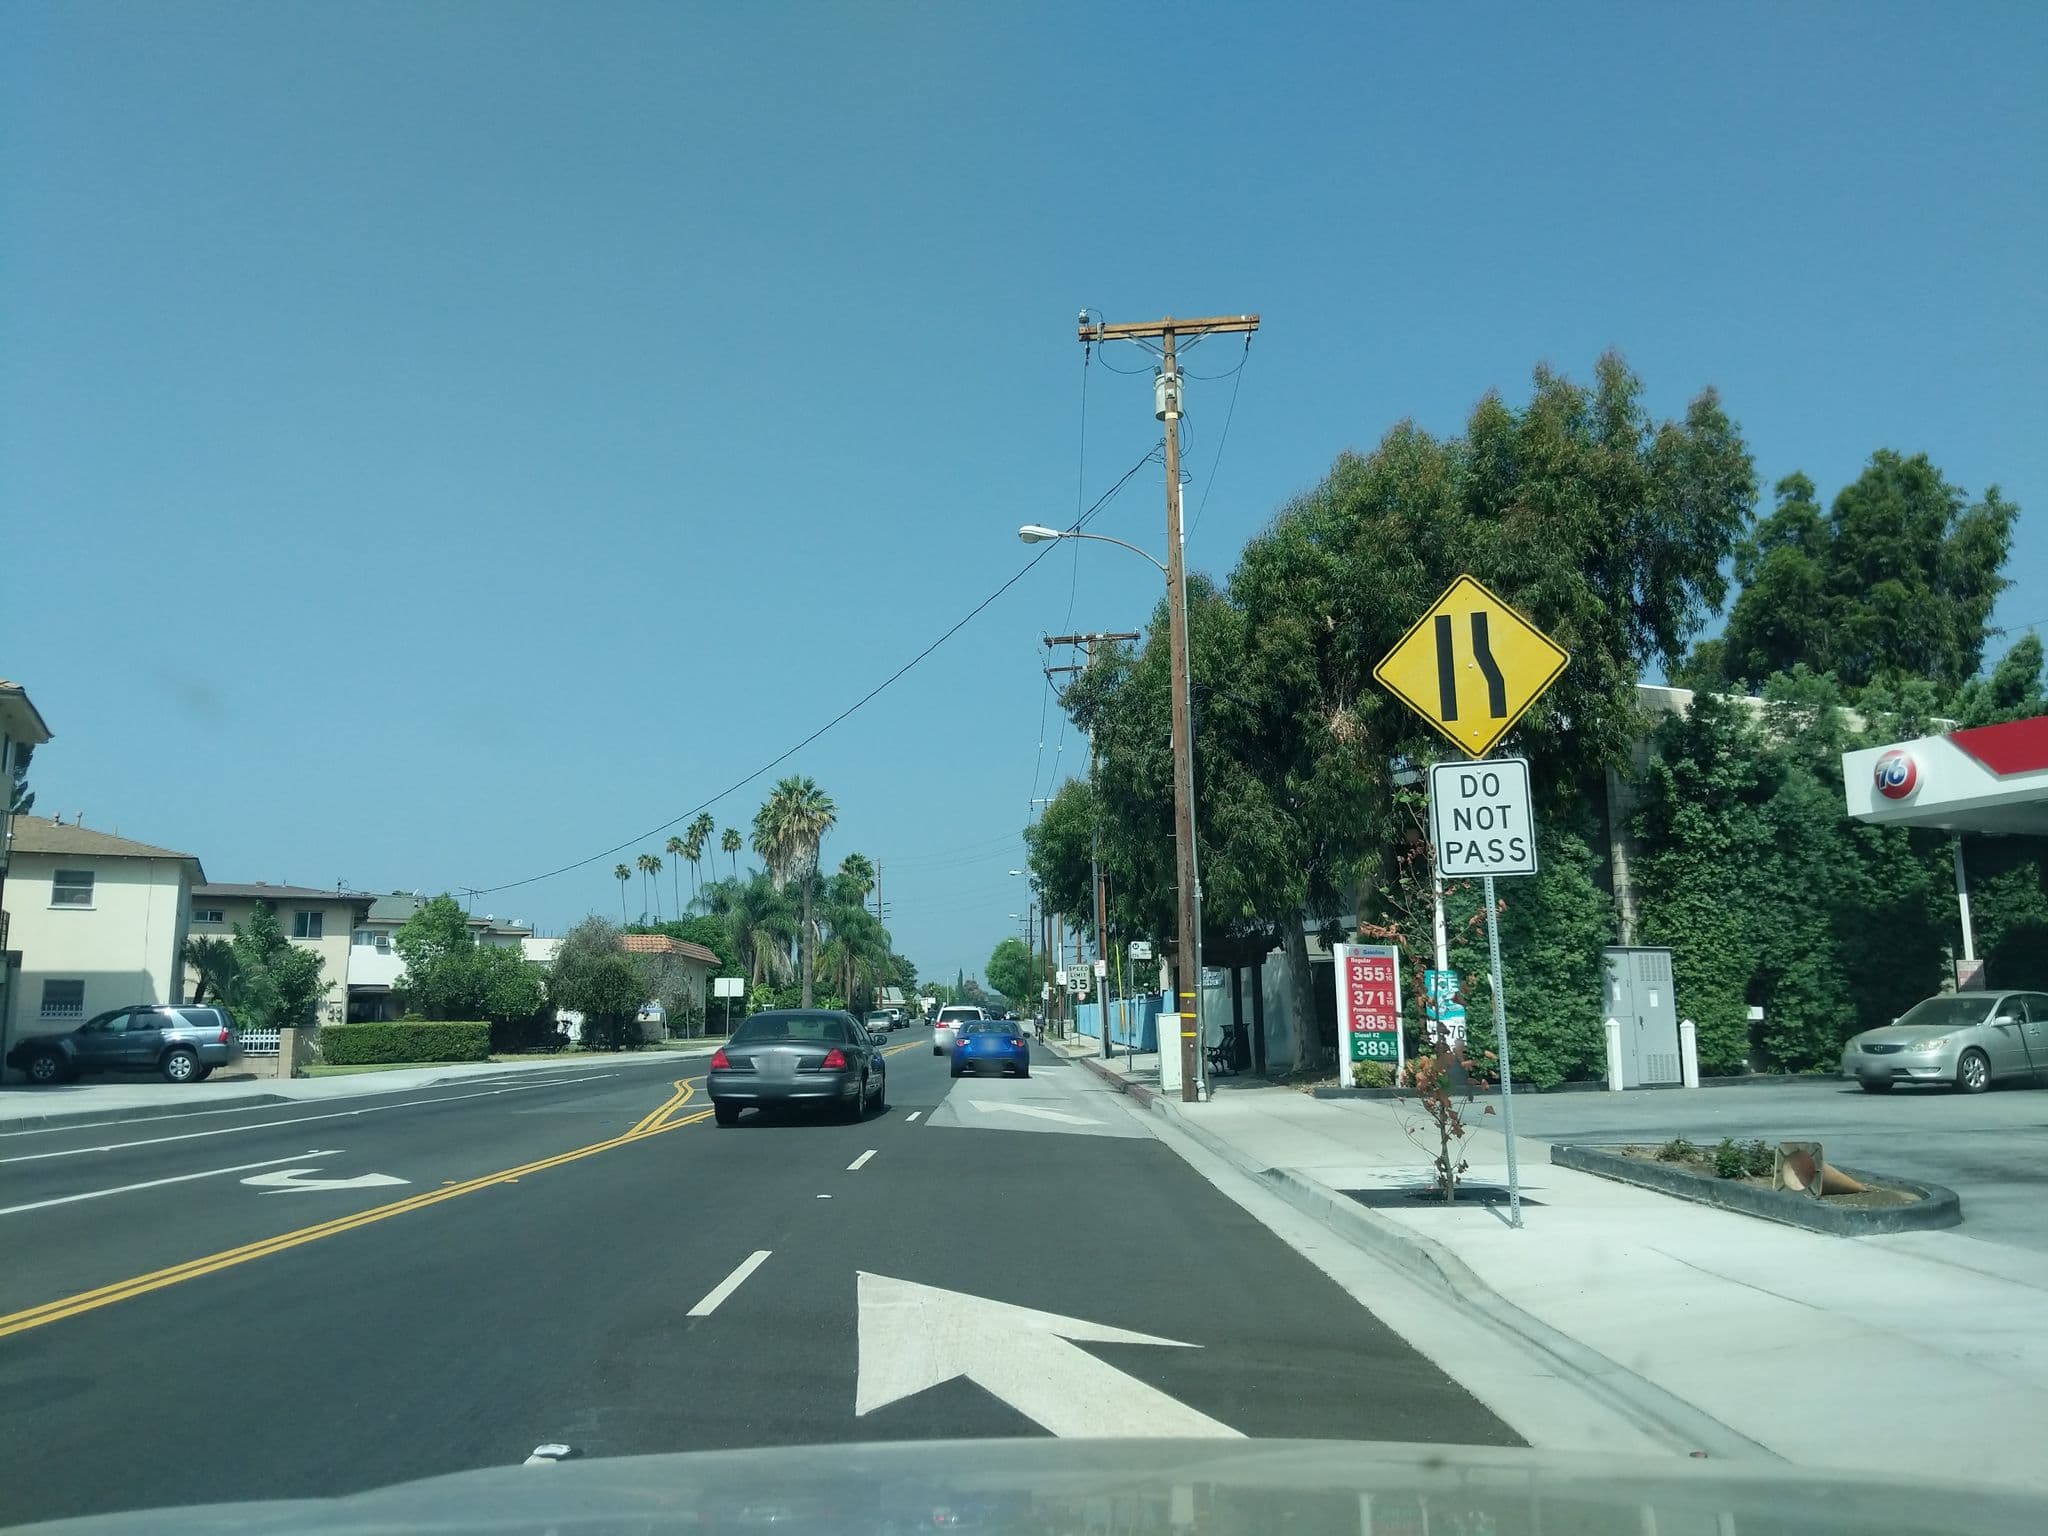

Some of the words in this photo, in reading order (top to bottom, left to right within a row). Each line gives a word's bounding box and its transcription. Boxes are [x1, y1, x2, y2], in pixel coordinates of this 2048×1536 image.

[1876, 758, 1907, 790] 76
[1460, 772, 1500, 798] DO
[1453, 804, 1511, 831] NOT
[1446, 837, 1526, 864] PASS
[1352, 966, 1385, 982] 355
[1070, 979, 1088, 990] 35
[1430, 974, 1460, 992] ICE
[1353, 991, 1385, 1006] 371
[1355, 1015, 1387, 1030] 385
[1356, 1041, 1389, 1056] 389
